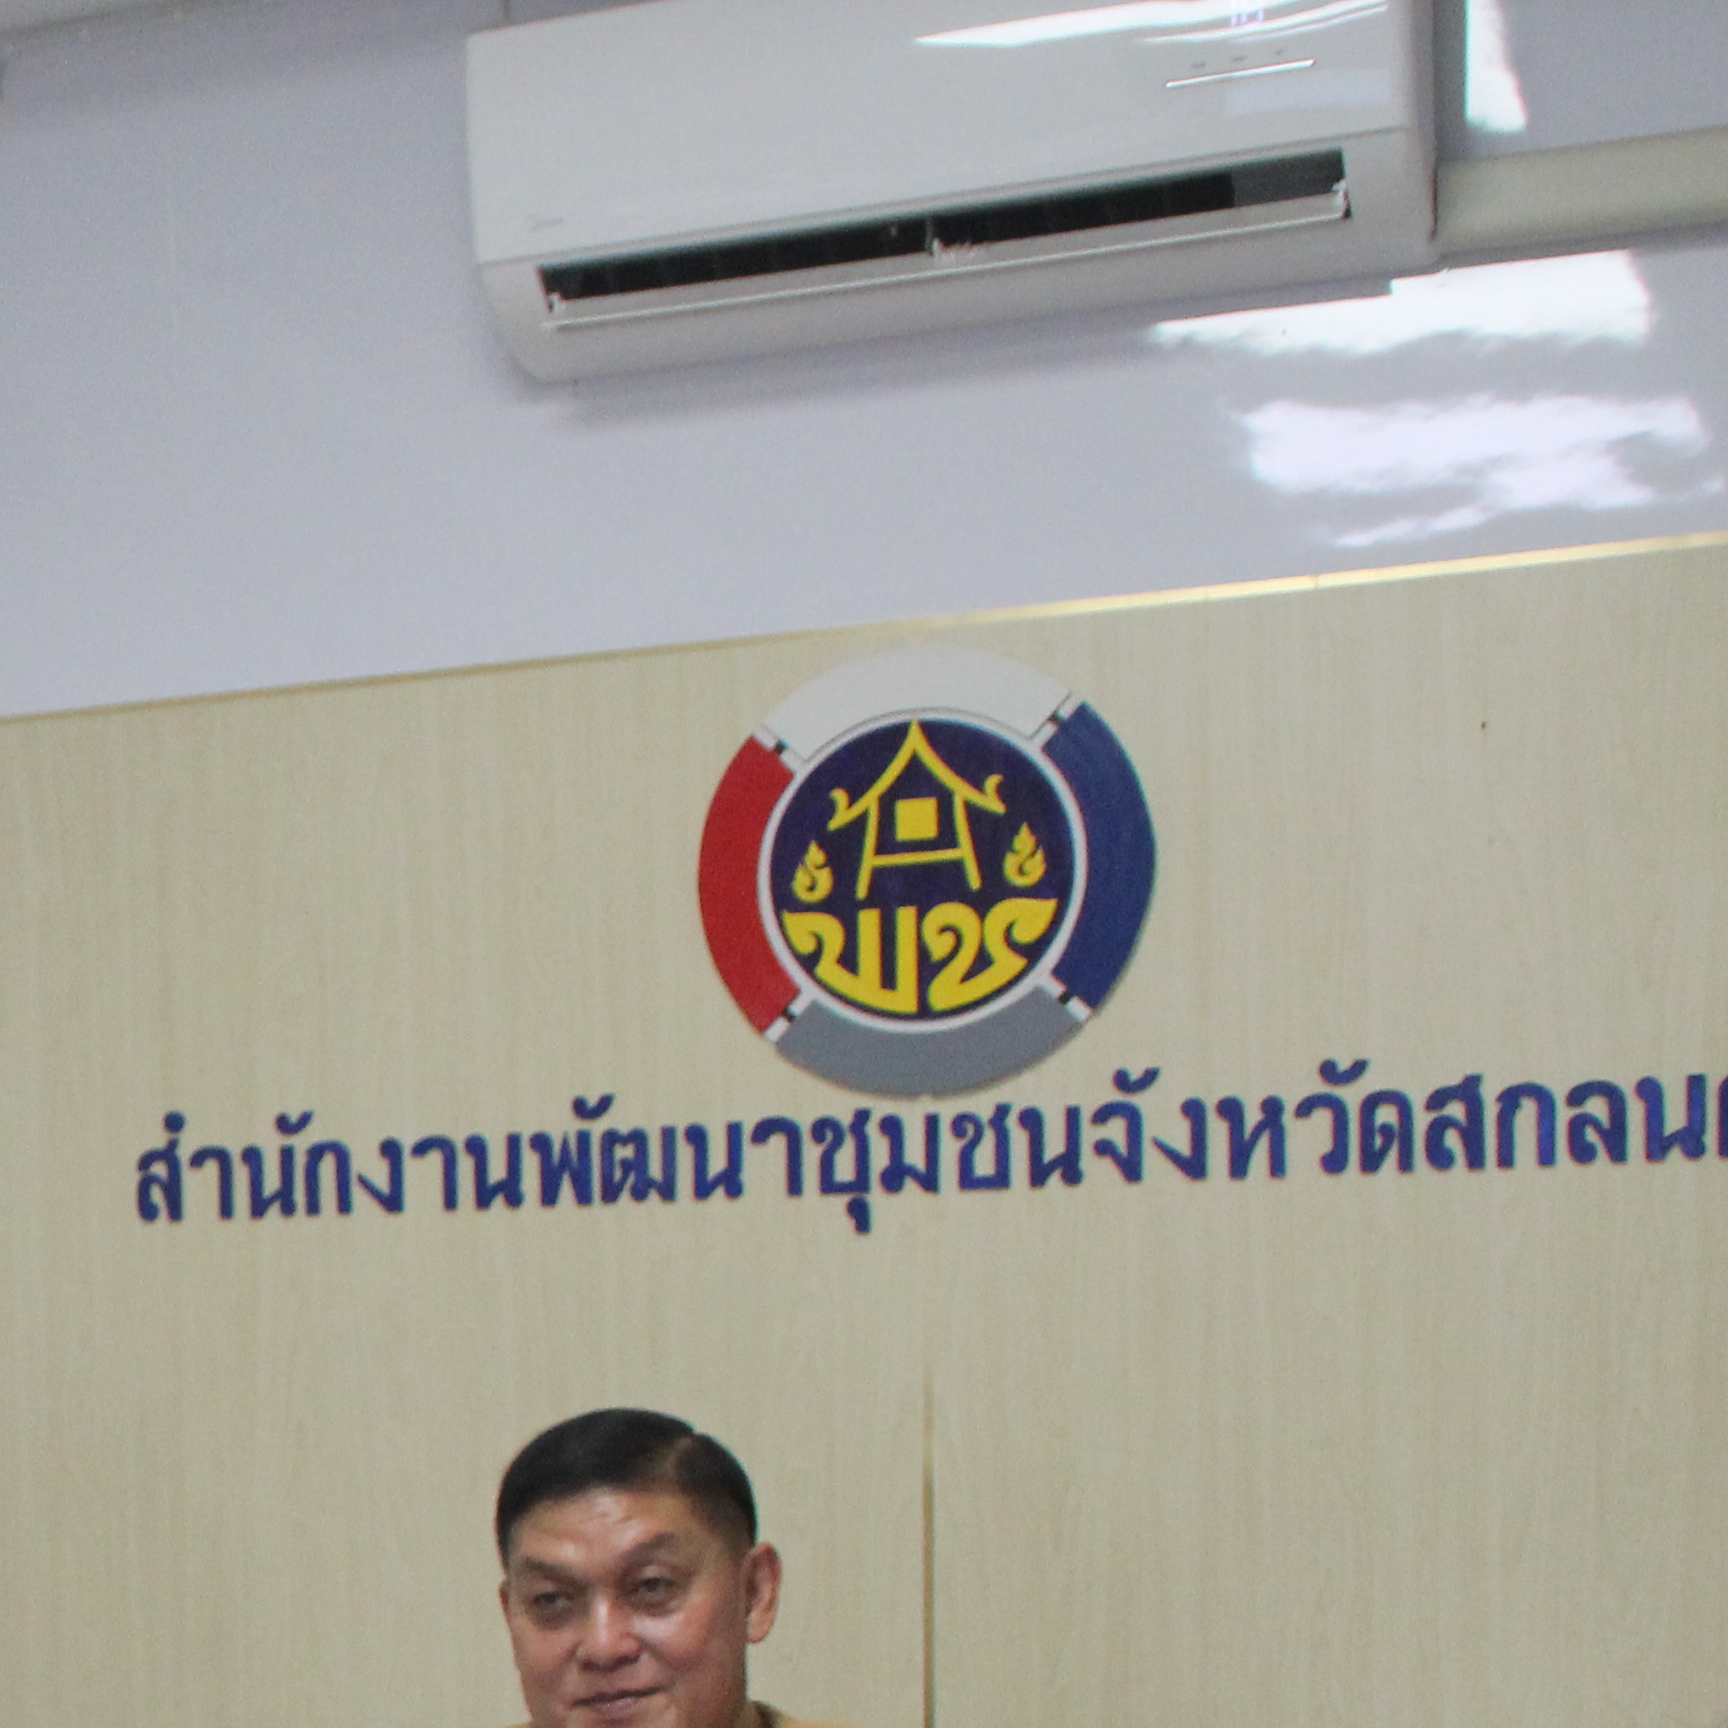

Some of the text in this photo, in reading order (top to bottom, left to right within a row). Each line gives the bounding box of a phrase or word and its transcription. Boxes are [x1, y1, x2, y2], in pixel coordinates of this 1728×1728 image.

[137, 1058, 1728, 1235] สำนักงานพัฒนาชุมชนจังหวัดสกลน
